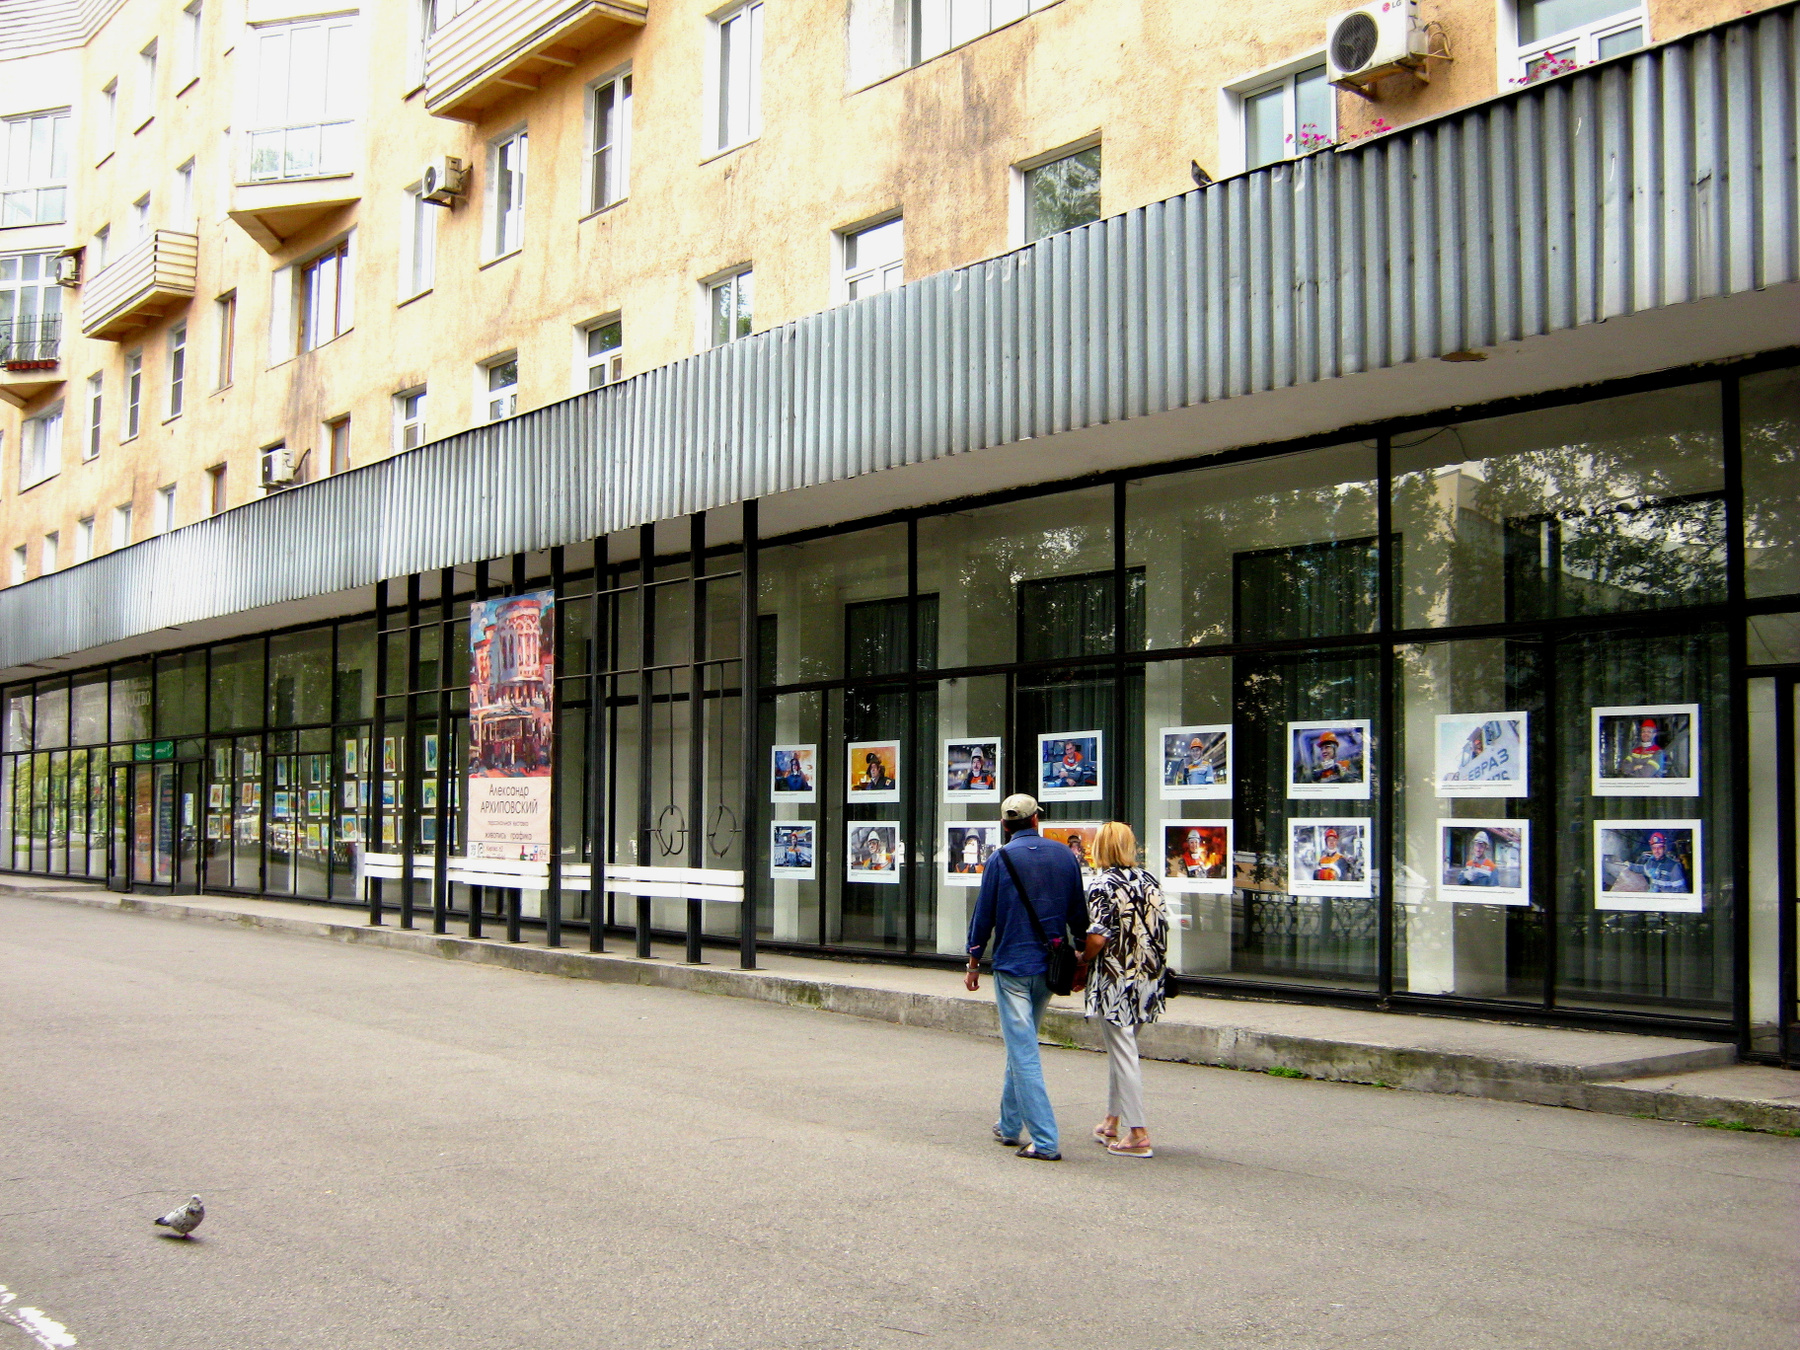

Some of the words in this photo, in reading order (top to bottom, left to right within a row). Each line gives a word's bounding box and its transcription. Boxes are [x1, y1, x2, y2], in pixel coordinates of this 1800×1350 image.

[1391, 0, 1402, 8] LG
[1468, 748, 1509, 781] ЕВРАЗ
[489, 783, 530, 799] Александр
[480, 798, 538, 814] АРХИПОВСКИЙ
[510, 831, 532, 841] графика
